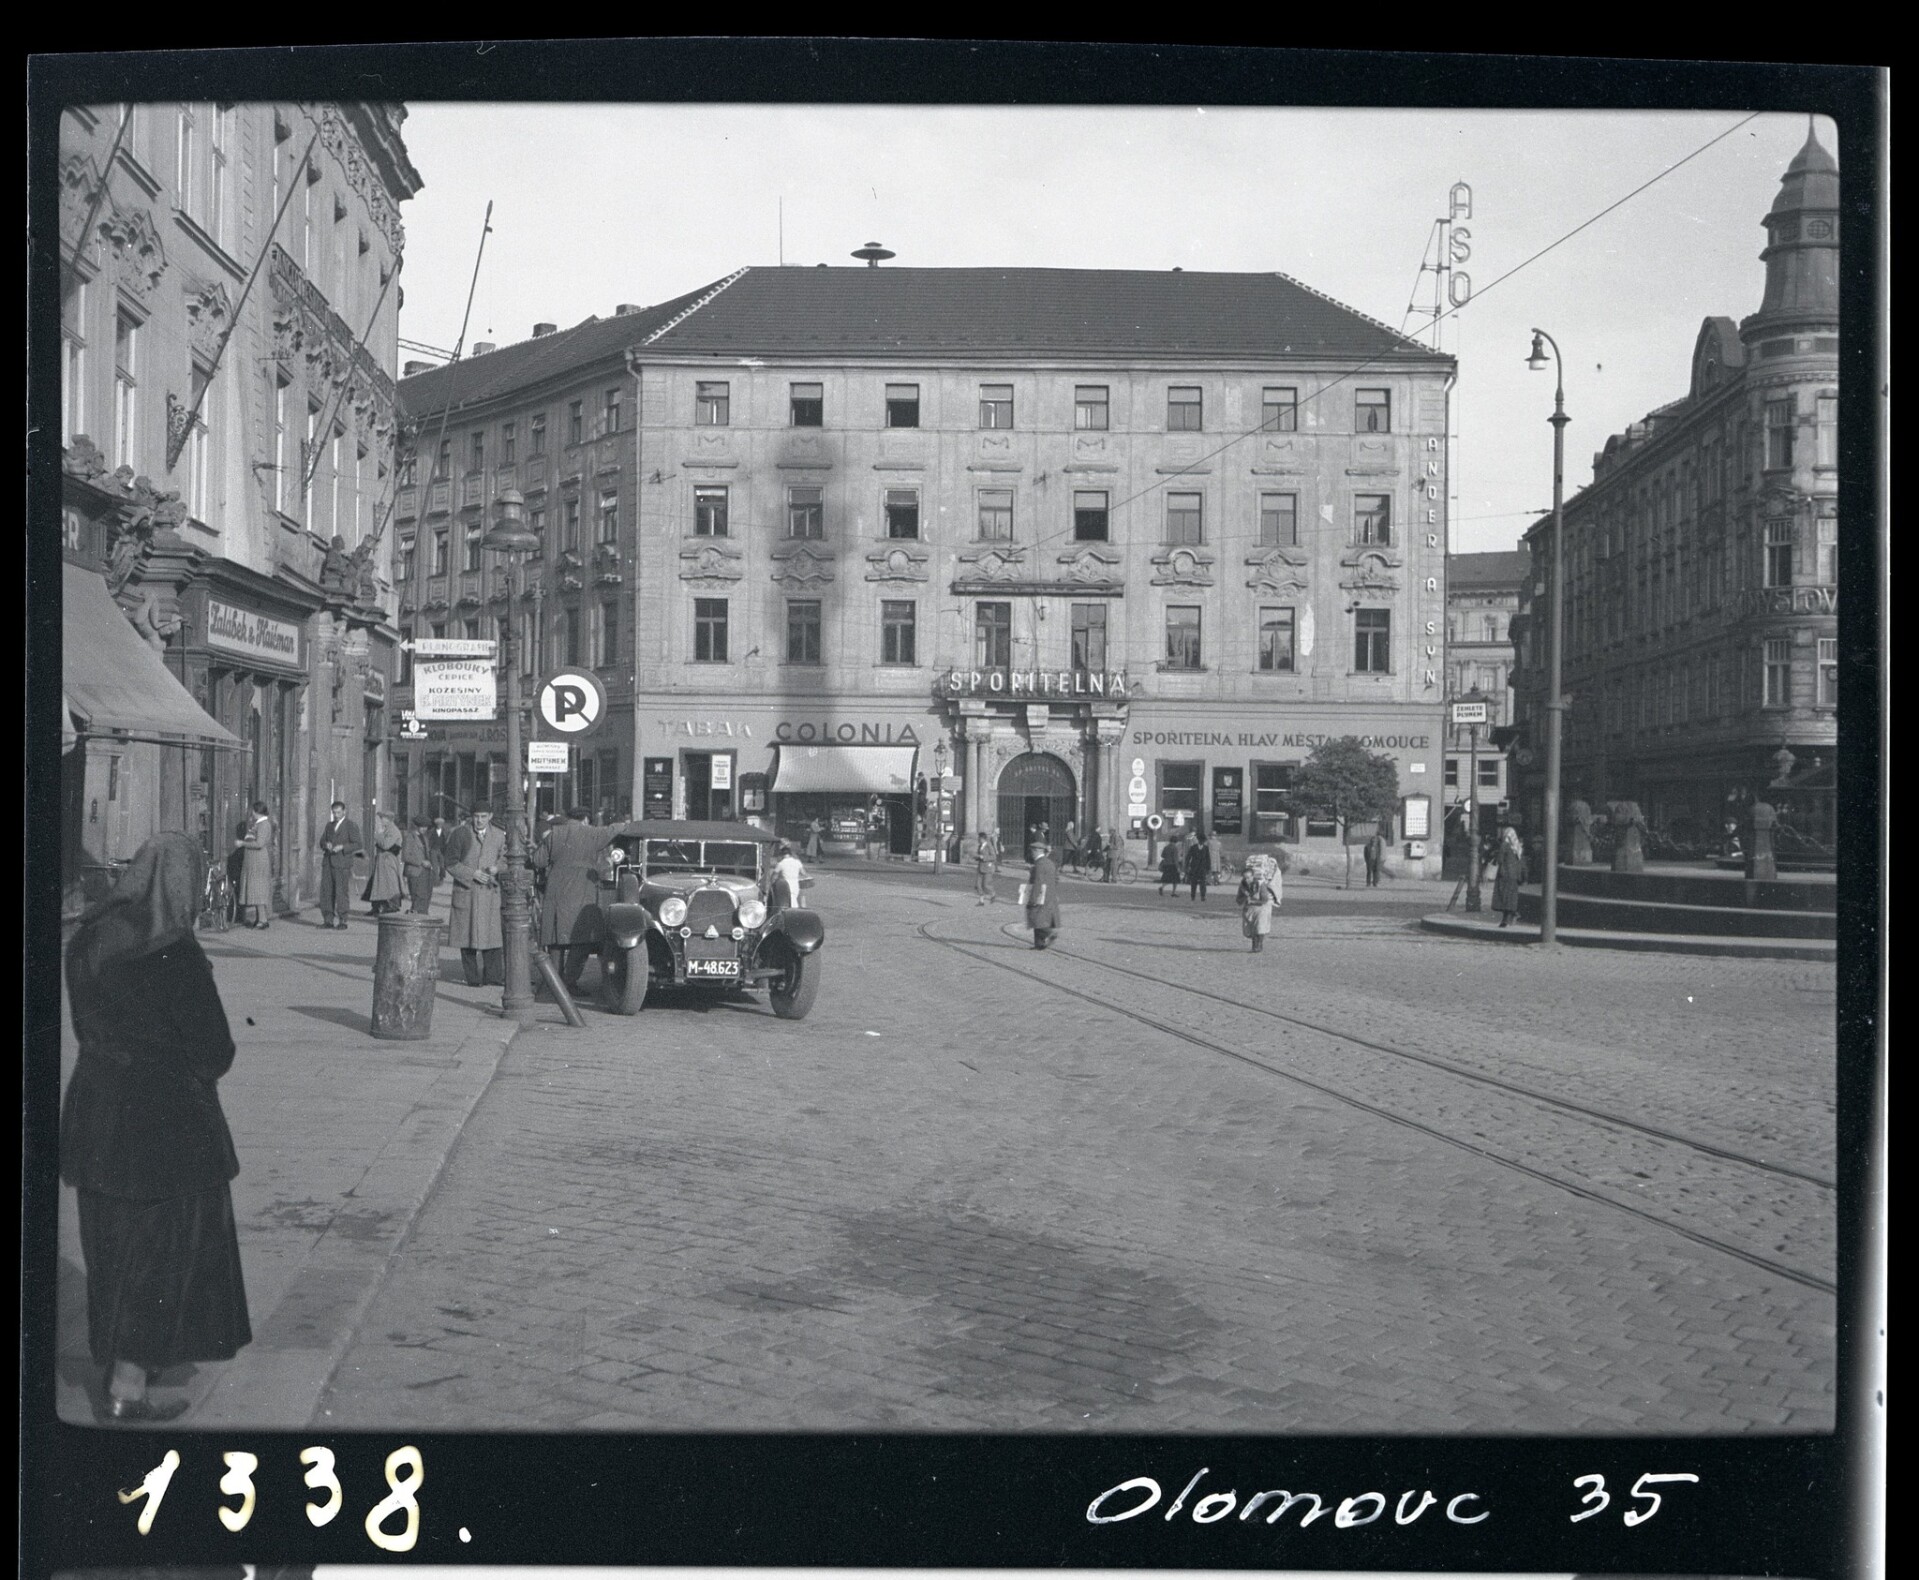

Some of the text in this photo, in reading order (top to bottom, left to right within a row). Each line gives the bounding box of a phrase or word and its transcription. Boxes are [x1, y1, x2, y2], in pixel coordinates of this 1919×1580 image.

[1425, 438, 1437, 684] ANDER A SYN
[248, 626, 255, 645] &
[423, 662, 490, 674] KLOBOUKY
[554, 685, 586, 722] P
[775, 722, 920, 743] COLONIA
